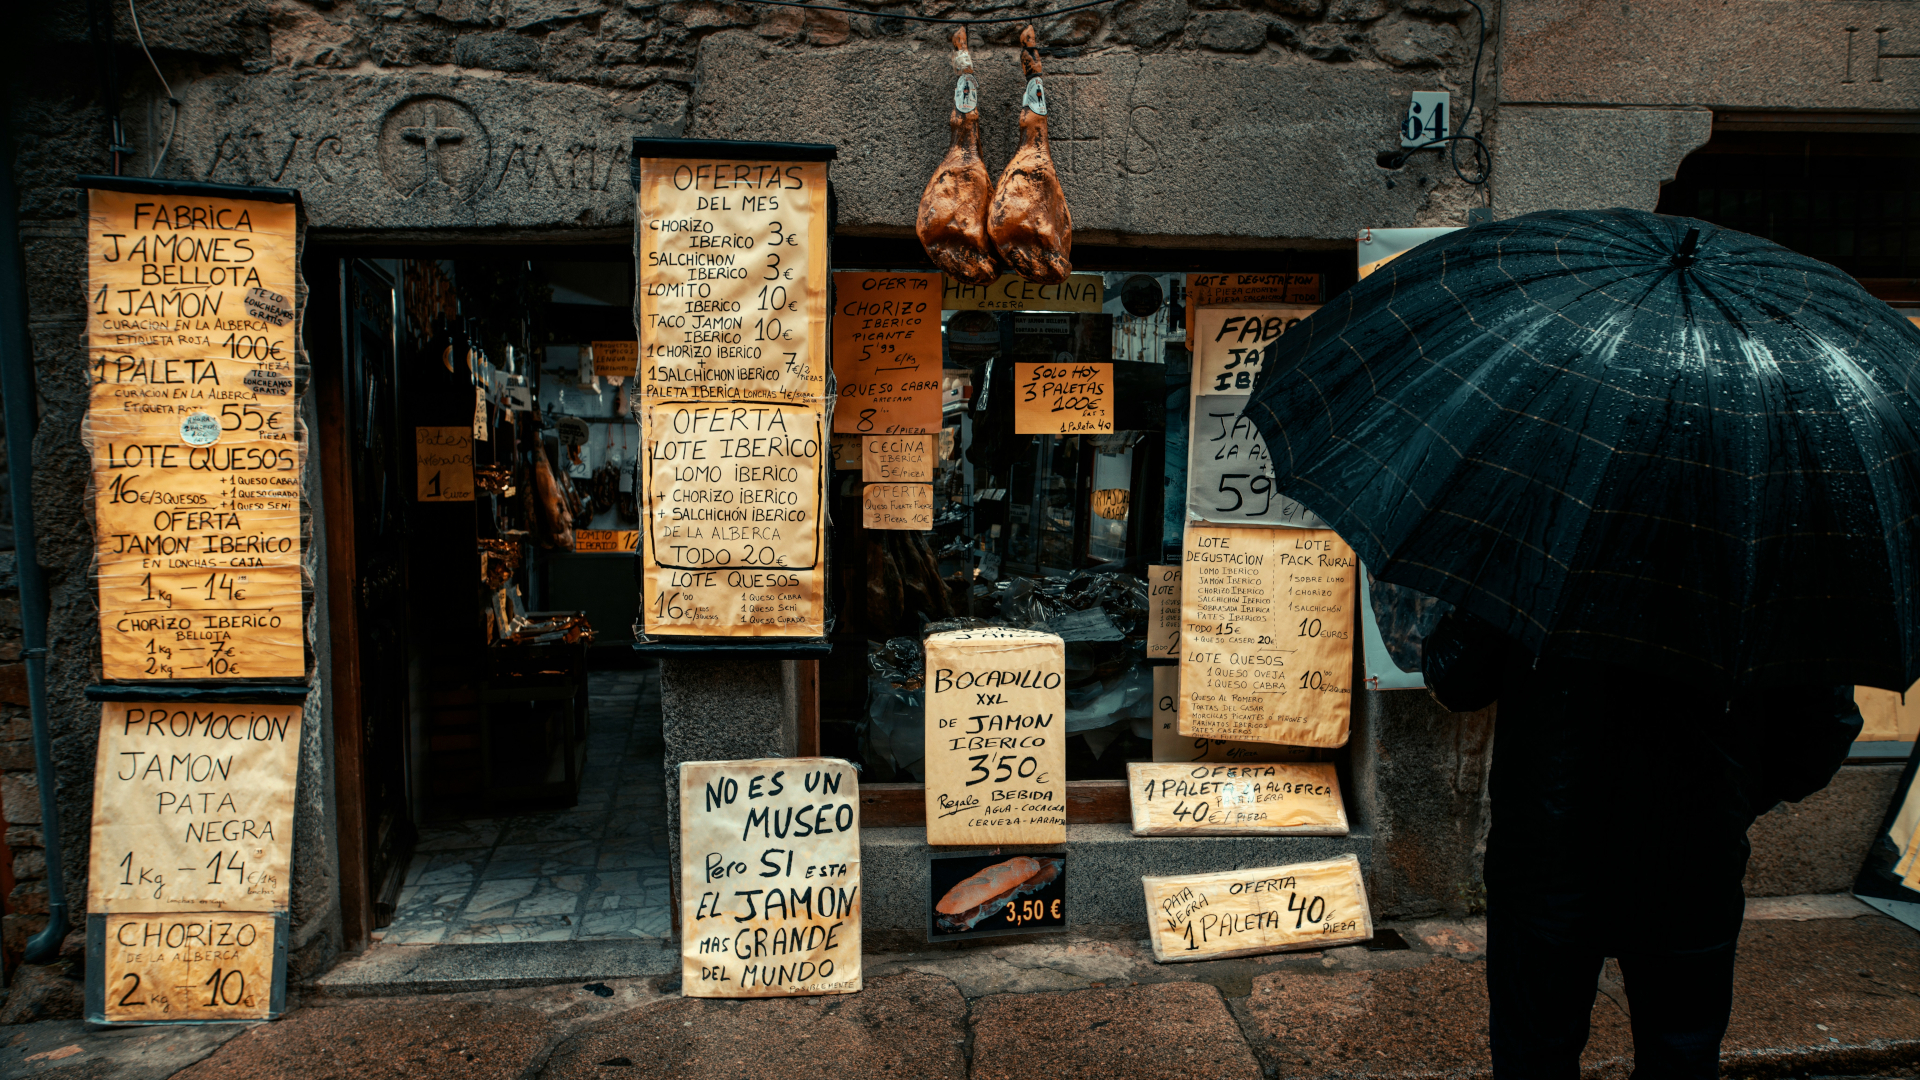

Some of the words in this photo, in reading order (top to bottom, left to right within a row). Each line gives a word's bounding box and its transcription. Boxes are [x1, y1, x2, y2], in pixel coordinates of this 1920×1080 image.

[1401, 100, 1448, 140] 64
[673, 164, 803, 191] OFERTAS
[696, 196, 731, 211] DEL
[742, 195, 779, 212] MES
[134, 202, 253, 232] FABRICA
[649, 217, 714, 234] CHORIZO
[102, 233, 254, 263] JAMONES
[688, 233, 754, 249] IBERICO
[141, 264, 262, 288] BELLOTA
[687, 267, 748, 282] IBERICO
[1195, 275, 1229, 287] LOTE
[861, 277, 928, 291] OFERTA
[1003, 280, 1098, 303] CECINA
[117, 288, 224, 318] JAMON
[684, 298, 741, 314] IBERICO
[843, 301, 927, 317] CHORIZO
[978, 301, 1024, 310] CASERA
[175, 319, 189, 330] EN
[195, 319, 210, 330] LA
[647, 313, 686, 329] TACO
[692, 315, 743, 330] JAMON
[861, 317, 922, 330] IBERICO
[116, 335, 174, 346] ETIQUETA
[179, 335, 210, 346] ROJA
[684, 331, 742, 345] IBERICO
[852, 330, 915, 342] PICANTE
[116, 355, 220, 385] PALETA
[1032, 365, 1067, 381] SOLO
[1072, 365, 1100, 381] HOY
[173, 388, 188, 399] EN
[190, 388, 204, 399] LA
[208, 388, 258, 401] ALBERCA
[646, 385, 688, 398] PALETA
[742, 390, 778, 399] LONCHAS
[841, 382, 894, 398] QUESO
[900, 380, 939, 392] CABRA
[1022, 383, 1037, 402] 3
[1042, 382, 1104, 399] PALETAS
[123, 402, 174, 414] ETIQUETA
[673, 407, 788, 435] OFERTA
[1068, 419, 1095, 431] Paleta
[652, 440, 708, 460] LOTE
[719, 434, 818, 460] IBERICO
[869, 438, 925, 454] CECINA
[108, 443, 179, 469] LOTE
[188, 446, 295, 472] QUESOS
[880, 453, 923, 463] IBERICA
[237, 477, 268, 485] QUESO
[269, 476, 299, 485] CABRA
[675, 465, 722, 483] LOMO
[734, 463, 798, 483] IBERICO
[672, 488, 734, 504] CHORIZO
[739, 487, 798, 506] IBERICO
[872, 485, 927, 498] OFERTA
[864, 499, 888, 511] QUESO
[890, 500, 913, 511] FUERTE
[153, 510, 242, 531] OFERTA
[751, 506, 806, 522] IBERICO
[577, 531, 612, 540] LOMITO
[687, 526, 704, 539] LA
[711, 525, 782, 541] ALBERCA
[111, 534, 190, 556] JAMON
[202, 531, 293, 554] IBERICO
[1198, 536, 1230, 549] LOTE
[1295, 538, 1331, 551] LOTE
[142, 558, 161, 569] EN
[168, 557, 217, 569] LONCHAS
[230, 557, 264, 568] CAJA
[669, 545, 731, 566] TODO
[1280, 553, 1314, 567] PACK
[1199, 567, 1219, 575] LOMO
[1222, 566, 1260, 575] IBERICO
[671, 571, 717, 588] LOTE
[727, 571, 800, 589] QUESOS
[1226, 576, 1262, 585] IBERICO
[1152, 585, 1174, 597] LOTE
[1295, 589, 1333, 597] CHORIZO
[116, 615, 192, 633] CHORIZO
[203, 615, 282, 630] IBERICO
[1187, 623, 1212, 634] TODO
[175, 630, 231, 642] BELLOTA
[1188, 651, 1222, 664] LOTE
[1230, 652, 1284, 667] QUESOS
[934, 668, 1061, 694] BOCADILLO
[1214, 667, 1248, 678] QUESO
[1254, 669, 1286, 680] OVEJA
[1214, 679, 1247, 689] QUESO
[1253, 681, 1286, 690] CABRA
[976, 693, 1008, 706] XXL
[1191, 691, 1216, 701] QUESO
[1232, 693, 1264, 703] ROMERO
[1191, 702, 1219, 712] TORTAS
[1240, 704, 1265, 712] CASAR
[124, 708, 291, 742] PROMOCION
[939, 718, 958, 729] DE
[966, 713, 1053, 735] JAMON
[948, 736, 1045, 751] IBERICO
[118, 751, 233, 783] JAMON
[1191, 765, 1276, 780] OFERTA
[705, 776, 739, 813] NO
[748, 770, 785, 800] ES
[804, 770, 843, 796] UN
[991, 789, 1053, 802] BEBIDA
[1162, 779, 1234, 799] PALETA
[1265, 781, 1332, 797] ALBERCA
[156, 791, 237, 815] PATA
[985, 804, 1011, 816] AGUA
[742, 803, 854, 842] MUSEO
[968, 816, 1020, 828] CERVEZA
[1236, 811, 1268, 822] PIEZA
[185, 819, 275, 843] NEGRA
[805, 863, 848, 879] ESTA
[1229, 875, 1298, 896] OFERTA
[695, 890, 722, 921] EL
[1162, 886, 1195, 917] PATA
[1006, 899, 1044, 925] 3,50
[1050, 899, 1061, 919] €
[1169, 892, 1209, 933] NEGRA
[117, 919, 257, 949] CHORIZO
[1199, 910, 1280, 943] PALETA
[1322, 920, 1357, 935] PIEZA
[699, 935, 731, 955] MAS
[734, 921, 844, 961] GRANDE
[126, 952, 143, 964] DE
[150, 951, 165, 963] LA
[171, 950, 240, 963] ALBERCA
[701, 965, 731, 982] DEL
[740, 958, 835, 988] MUNDO
